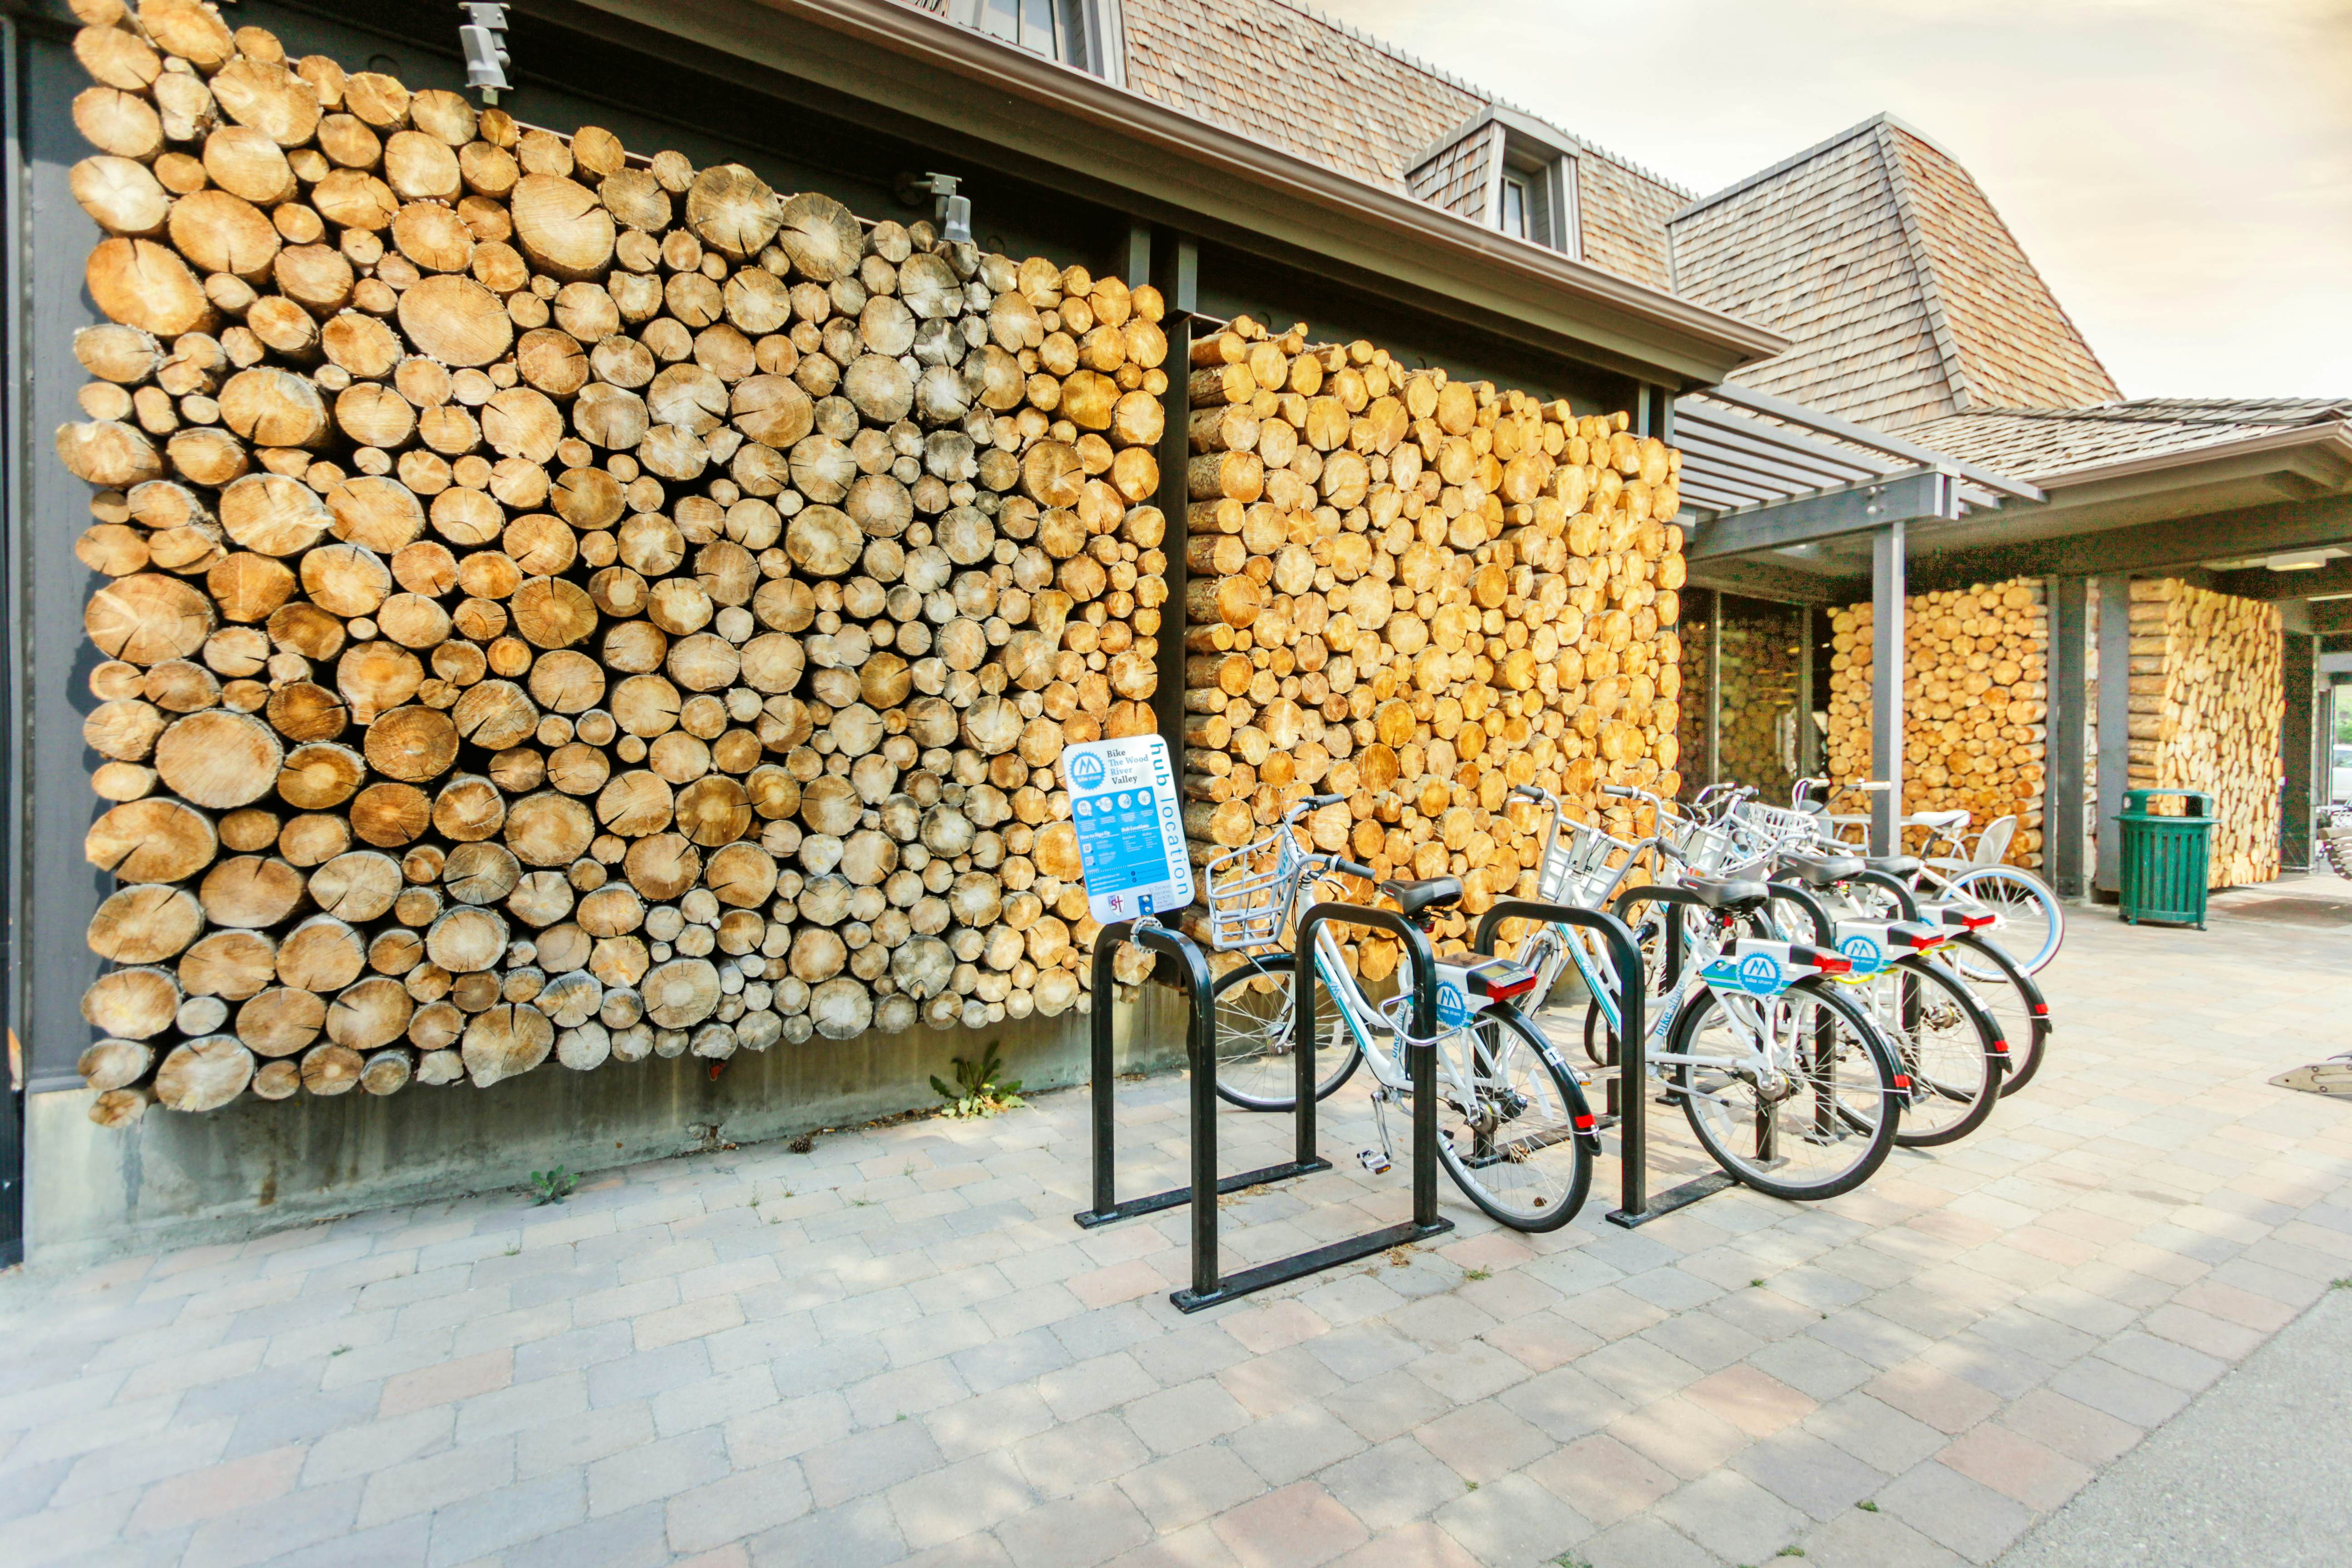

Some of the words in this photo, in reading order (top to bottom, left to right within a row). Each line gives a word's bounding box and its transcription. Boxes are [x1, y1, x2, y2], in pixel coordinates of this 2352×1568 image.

[1107, 750, 1126, 758] Bike
[1126, 754, 1149, 764] Wood
[1111, 767, 1132, 775] River
[1112, 776, 1137, 784] Valley
[1150, 743, 1170, 786] hub
[1161, 798, 1188, 895] location
[1655, 1012, 1672, 1036] bike
[1668, 980, 1686, 1010] share
